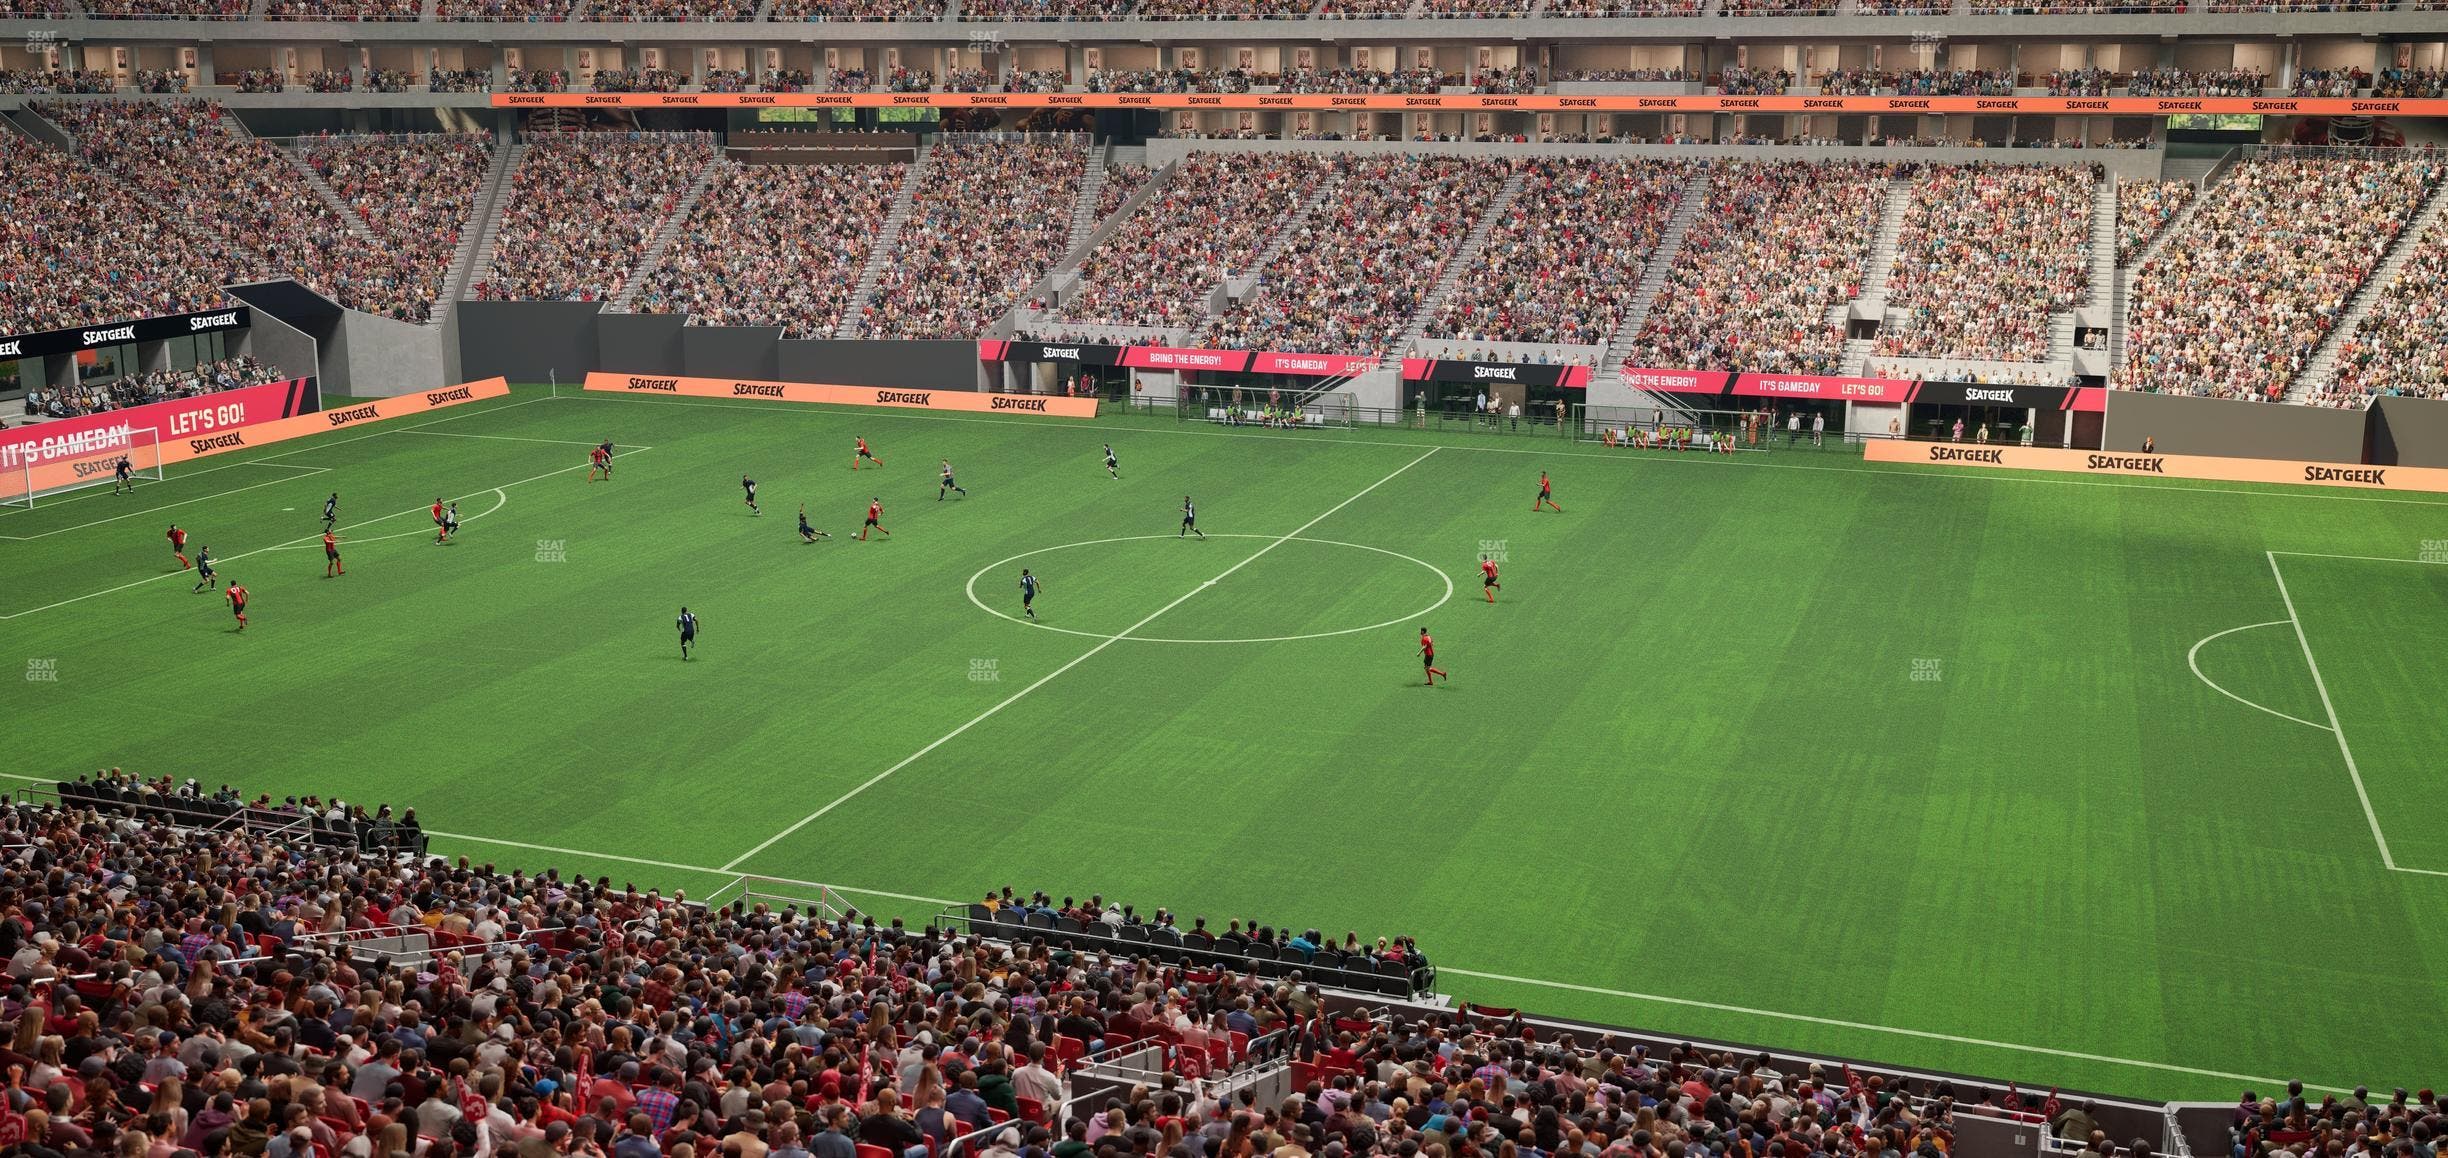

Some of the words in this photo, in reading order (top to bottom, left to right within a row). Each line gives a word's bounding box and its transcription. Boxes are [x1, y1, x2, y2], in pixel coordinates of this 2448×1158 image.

[509, 96, 544, 104] SEATGEEK
[586, 96, 621, 104] SEATGEEK
[663, 96, 698, 104] SEATGEEK
[740, 96, 775, 104] SEATGEEK
[817, 96, 852, 104] SEATGEEK
[894, 96, 929, 104] SEATGEEK
[971, 96, 1006, 104] SEATGEEK
[1049, 96, 1083, 104] SEATGEEK
[1119, 96, 1151, 104] SEATGEEK
[1189, 96, 1221, 104] SEATGEEK
[1259, 97, 1292, 105] SEATGEEK
[1331, 97, 1366, 105] SEATGEEK
[1405, 98, 1438, 106] SEATGEEK
[1483, 98, 1518, 106] SEATGEEK
[1560, 98, 1596, 106] SEATGEEK
[1639, 99, 1676, 107] SEATGEEK
[1720, 99, 1758, 107] SEATGEEK
[1804, 100, 1843, 108] SEATGEEK
[1889, 100, 1930, 108] SEATGEEK
[1976, 100, 2018, 109] SEATGEEK
[2066, 101, 2109, 109] SEATGEEK
[2158, 101, 2202, 110] SEATGEEK
[2252, 102, 2298, 110] SEATGEEK
[2351, 102, 2399, 111] SEATGEEK
[83, 325, 135, 345] SEATGEEK
[190, 312, 237, 330] SEATGEEK
[1043, 347, 1079, 360] SEATGEEK
[1150, 353, 1173, 363] BRING
[1174, 355, 1188, 364] THE
[1190, 355, 1221, 365] ENERGY!
[1275, 358, 1289, 368] IT'S
[1291, 359, 1328, 370] GAMEDAY
[1474, 366, 1516, 380] SEATGEEK
[1661, 376, 1697, 387] ENERGY!
[1759, 380, 1776, 391] IT'S
[1778, 380, 1821, 393] GAMEDAY
[1841, 383, 1865, 394] LET'S
[1868, 384, 1884, 395] GO!
[628, 378, 678, 392] SEATGEEK
[733, 383, 785, 397] SEATGEEK
[877, 391, 931, 405] SEATGEEK
[991, 397, 1047, 411] SEATGEEK
[1966, 388, 2013, 403] SEATGEEK
[169, 408, 214, 435] LET'S
[217, 402, 244, 426] GO!
[190, 432, 245, 453] SEATGEEK
[328, 405, 380, 426] SEATGEEK
[426, 387, 473, 406] SEATGEEK
[2, 441, 38, 468] IT'S
[42, 424, 128, 459] GAMEDAY
[1930, 446, 2003, 464] SEATGEEK
[2088, 454, 2164, 473] SEATGEEK
[2305, 466, 2385, 485] SEATGEEK
